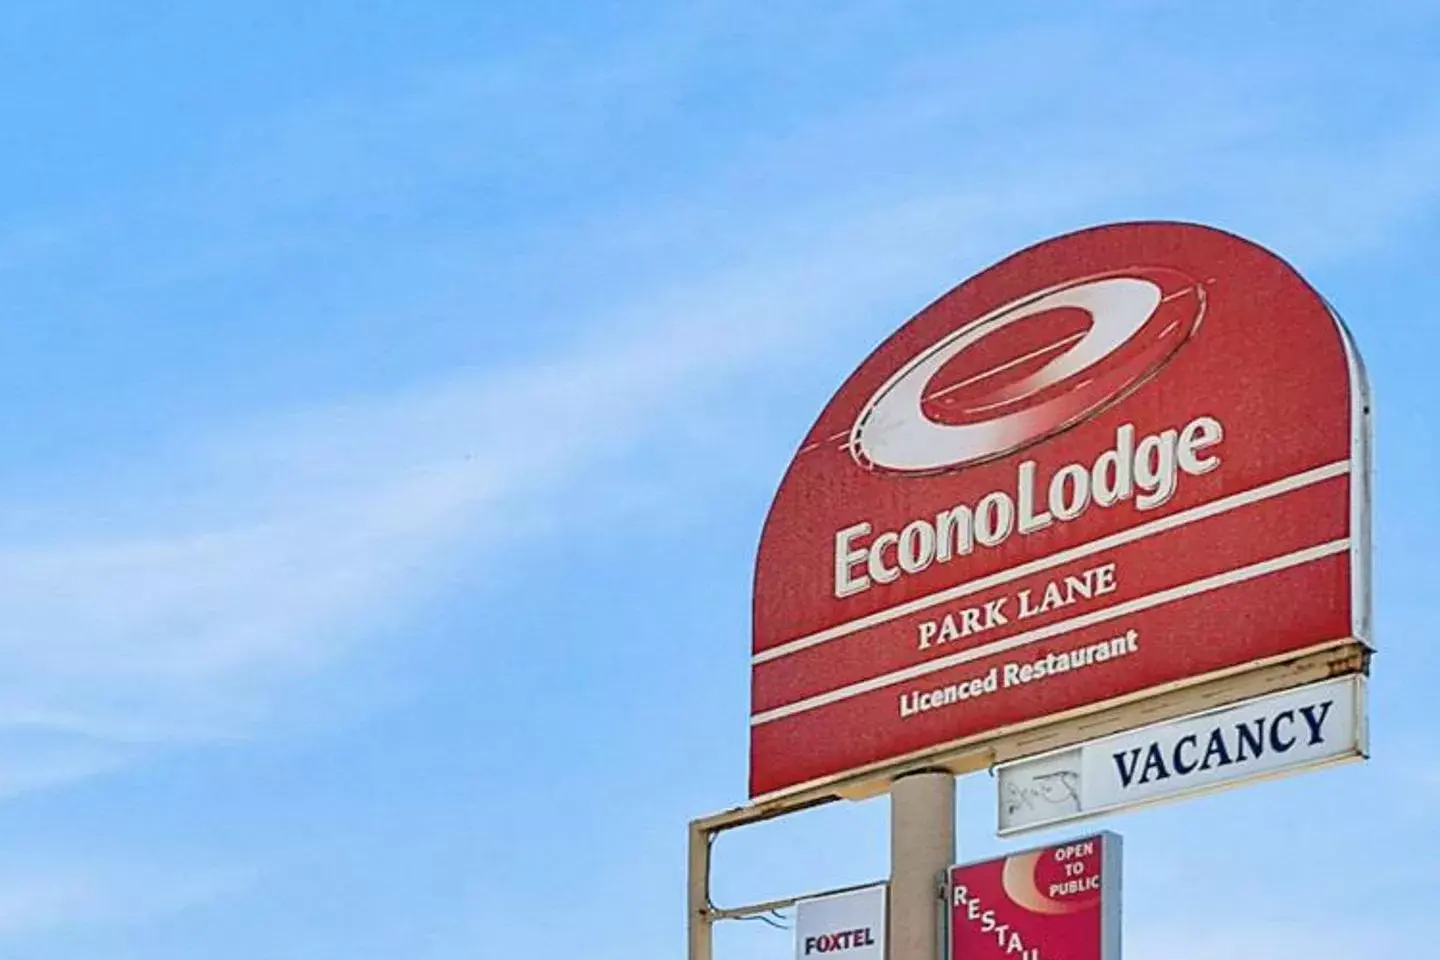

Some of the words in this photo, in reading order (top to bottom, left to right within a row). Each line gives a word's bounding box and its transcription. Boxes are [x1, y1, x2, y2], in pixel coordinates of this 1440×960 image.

[834, 416, 1224, 599] EconoLodge
[917, 598, 1009, 651] PARK
[1017, 563, 1118, 620] LANE
[899, 668, 998, 718] Licenced
[1003, 628, 1139, 688] Restaurant
[1112, 700, 1334, 789] VACANCY
[1054, 842, 1094, 861] OPEN
[1064, 862, 1084, 877] TO
[1049, 875, 1101, 897] PUBLIC
[805, 927, 875, 955] FOXTEL
